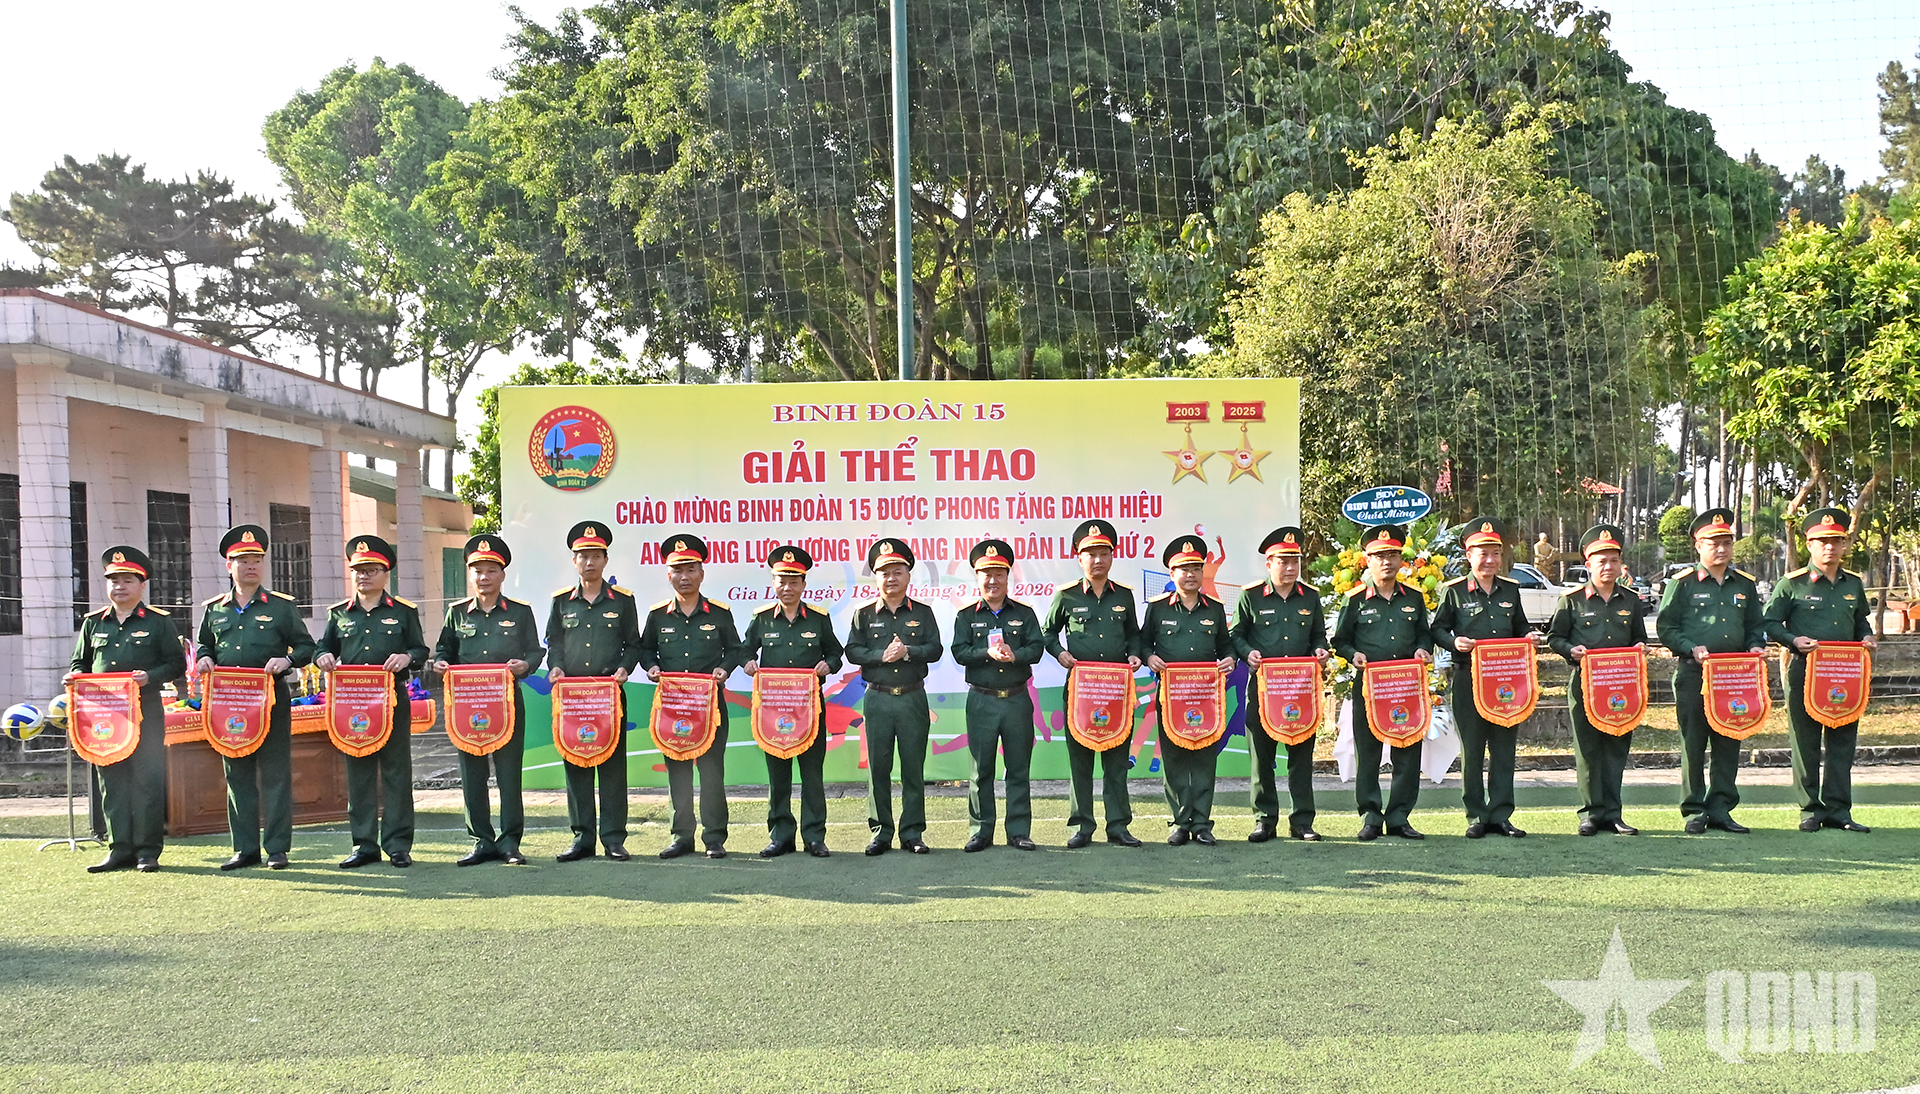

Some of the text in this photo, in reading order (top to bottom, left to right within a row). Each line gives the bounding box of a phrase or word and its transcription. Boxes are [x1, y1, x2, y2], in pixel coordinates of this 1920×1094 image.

[773, 399, 1005, 422] BINH ĐOÀN 15
[1175, 407, 1201, 416] 2003
[1230, 407, 1256, 415] 2025
[743, 436, 1036, 484] GIẢI THỂ THAO
[616, 490, 1162, 525] CHÀO MỪNG BINH ĐOÀN 15 ĐƯỢC PHONG TẶNG DANH HIỆU
[1347, 502, 1368, 511] BIDV
[1394, 499, 1409, 508] GIA
[1411, 498, 1427, 507] LAI
[641, 541, 668, 565] AN
[788, 537, 850, 568] ƯỢNG
[1014, 532, 1053, 560] DÂN
[1113, 531, 1140, 559] HỨ
[1144, 535, 1155, 559] 2
[728, 586, 758, 600] Gia
[803, 586, 846, 602] ngày
[909, 584, 953, 601] háng
[956, 584, 967, 597] 3
[1014, 583, 1055, 597] 2026
